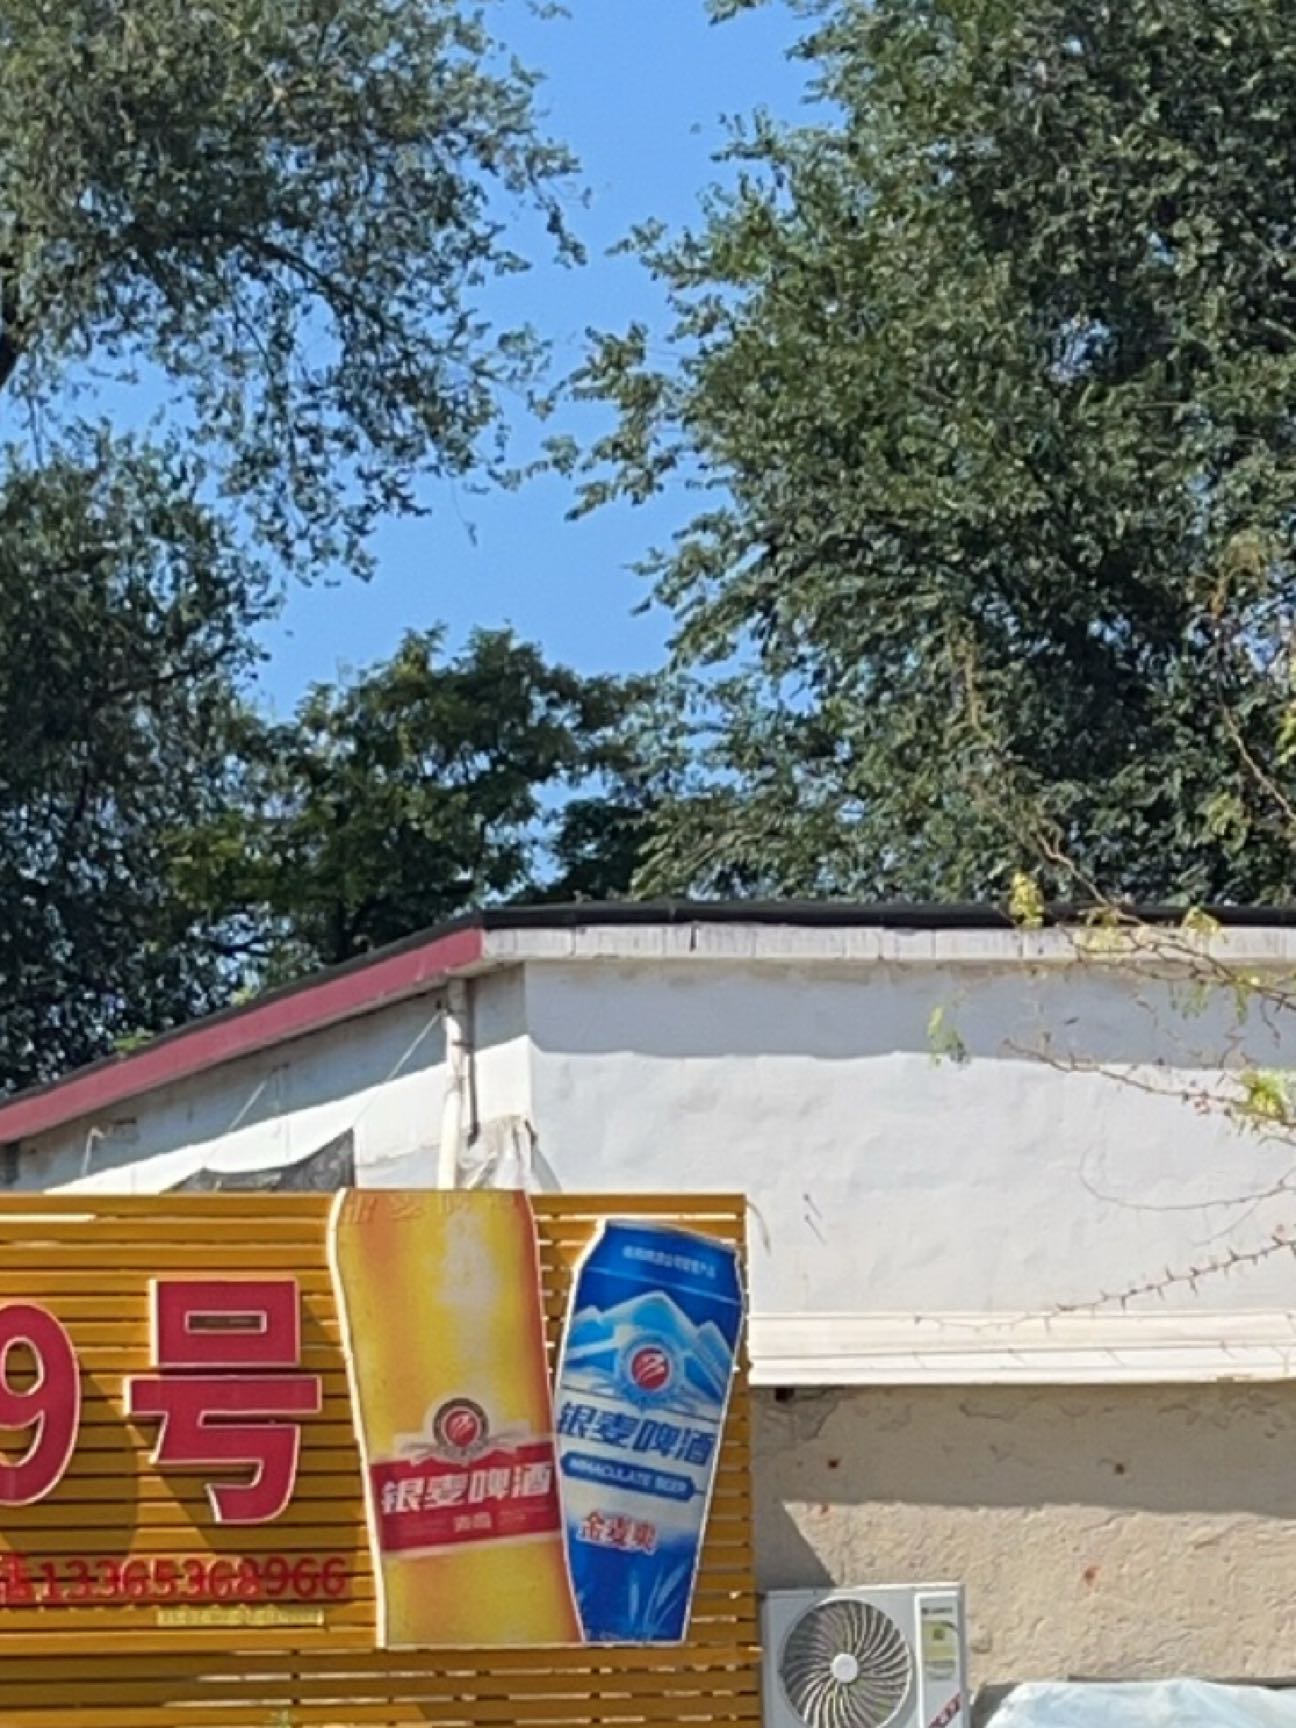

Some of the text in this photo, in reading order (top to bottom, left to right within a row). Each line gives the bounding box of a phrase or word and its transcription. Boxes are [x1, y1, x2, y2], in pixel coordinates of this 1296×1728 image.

[558, 1401, 715, 1467] 银麦啤酒
[381, 1461, 553, 1515] 银麦啤酒
